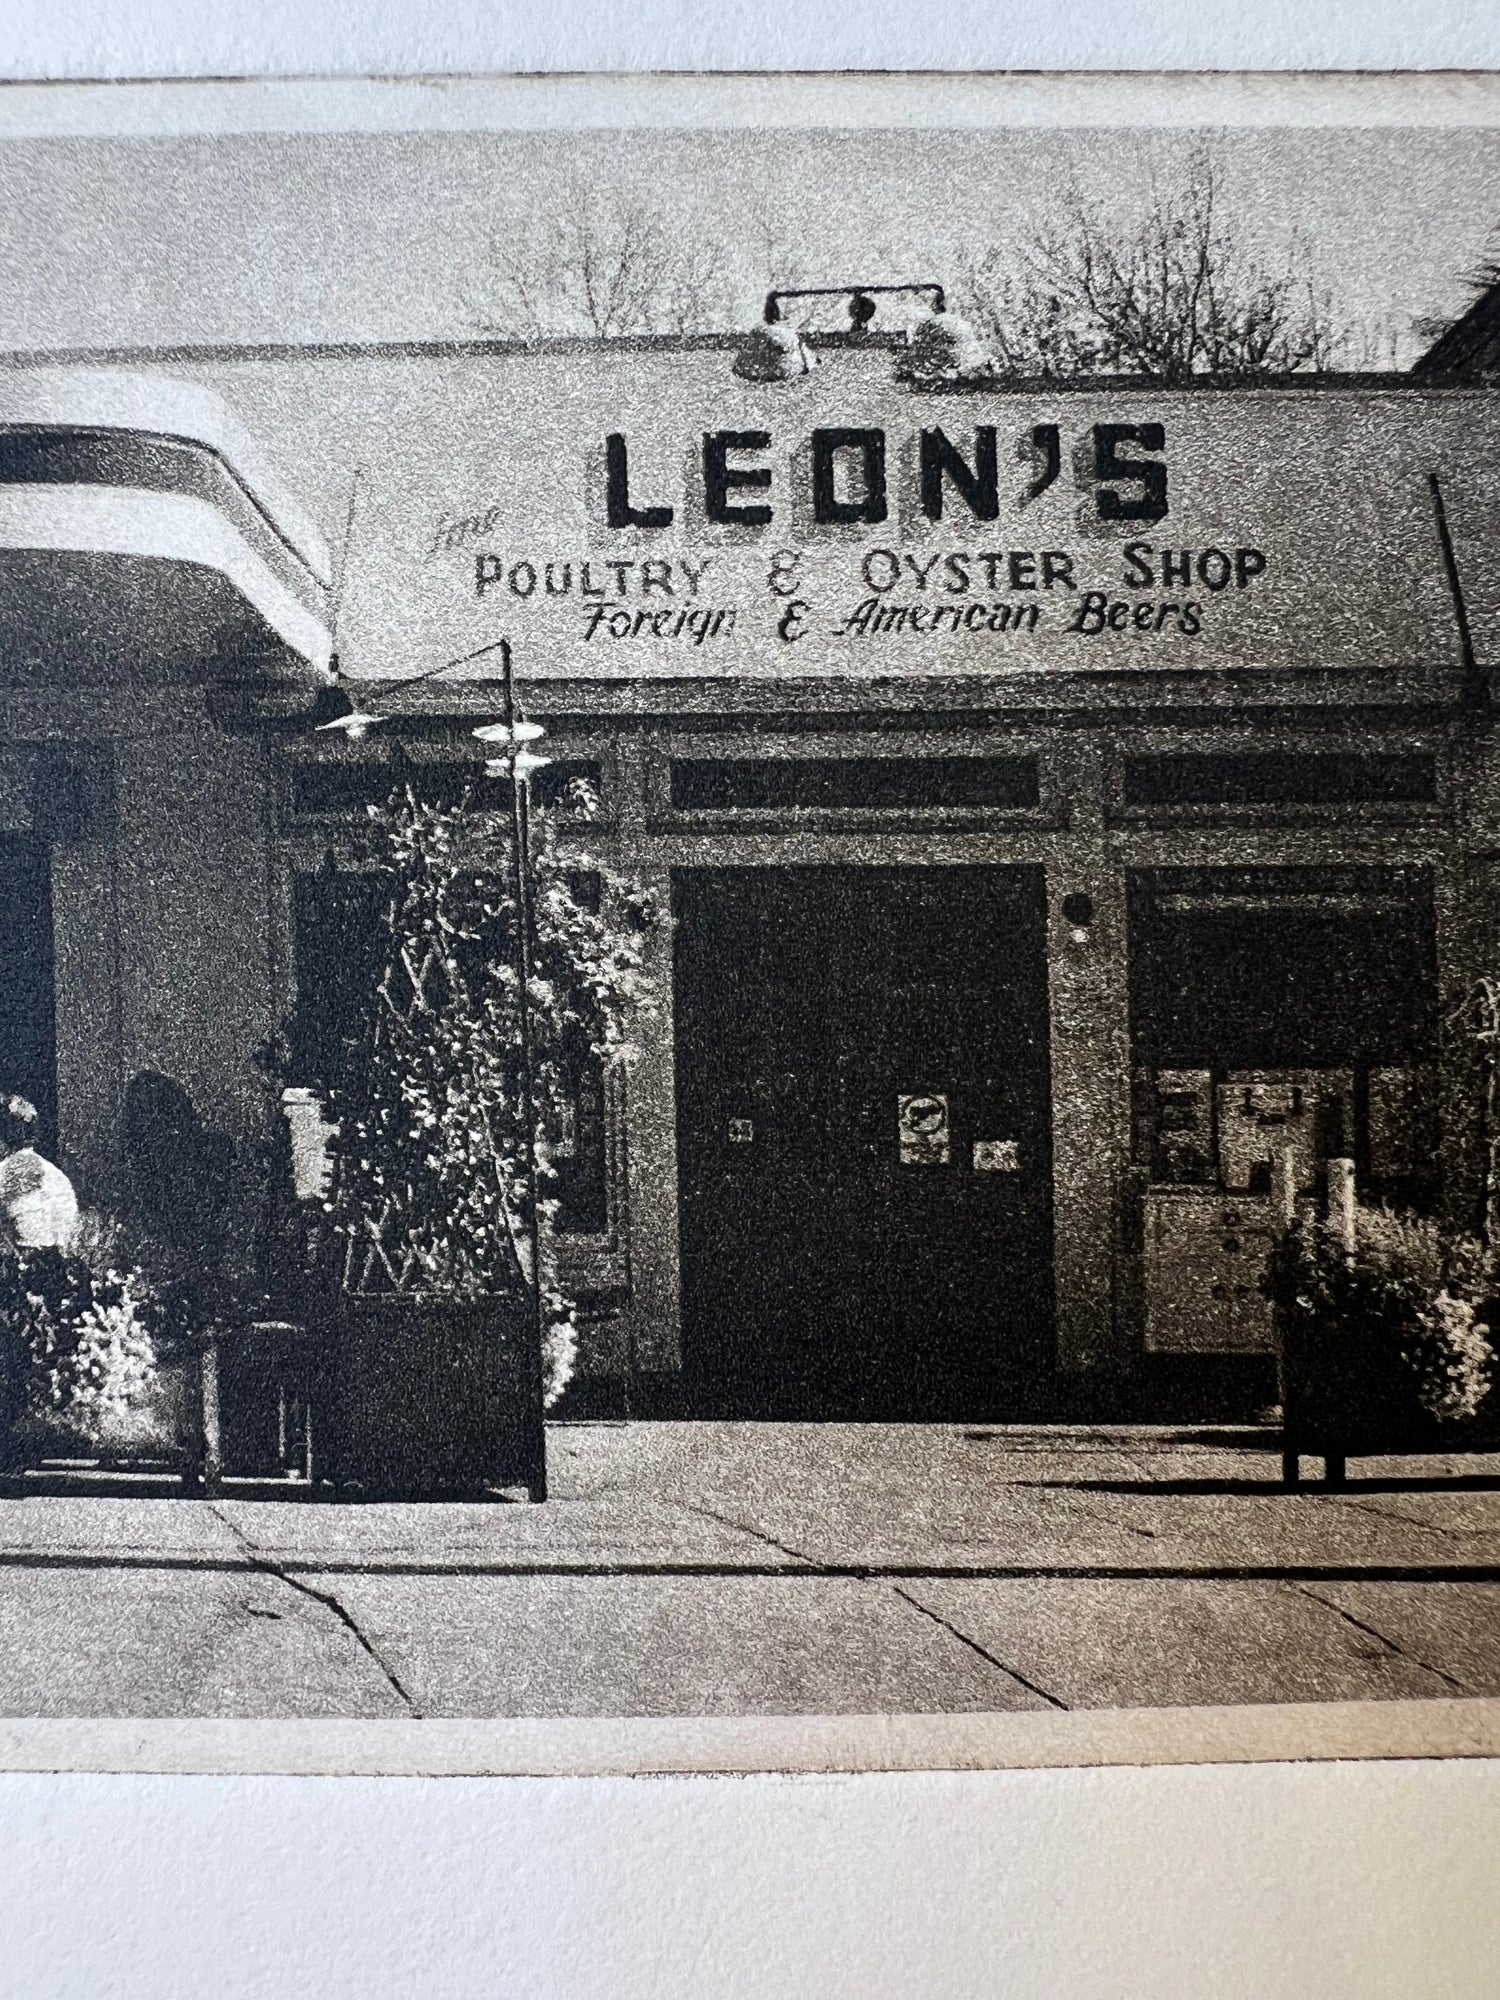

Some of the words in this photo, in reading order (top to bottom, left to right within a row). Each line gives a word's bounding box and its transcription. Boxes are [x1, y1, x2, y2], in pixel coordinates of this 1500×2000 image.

[603, 421, 1169, 529] LEON'S
[473, 553, 711, 600] POULTRY
[767, 547, 802, 597] &
[861, 546, 1078, 594] OYSTER
[1122, 541, 1268, 592] SHOP
[581, 600, 737, 647] Foreign
[832, 597, 1040, 637] American
[1069, 589, 1202, 637] Beers
